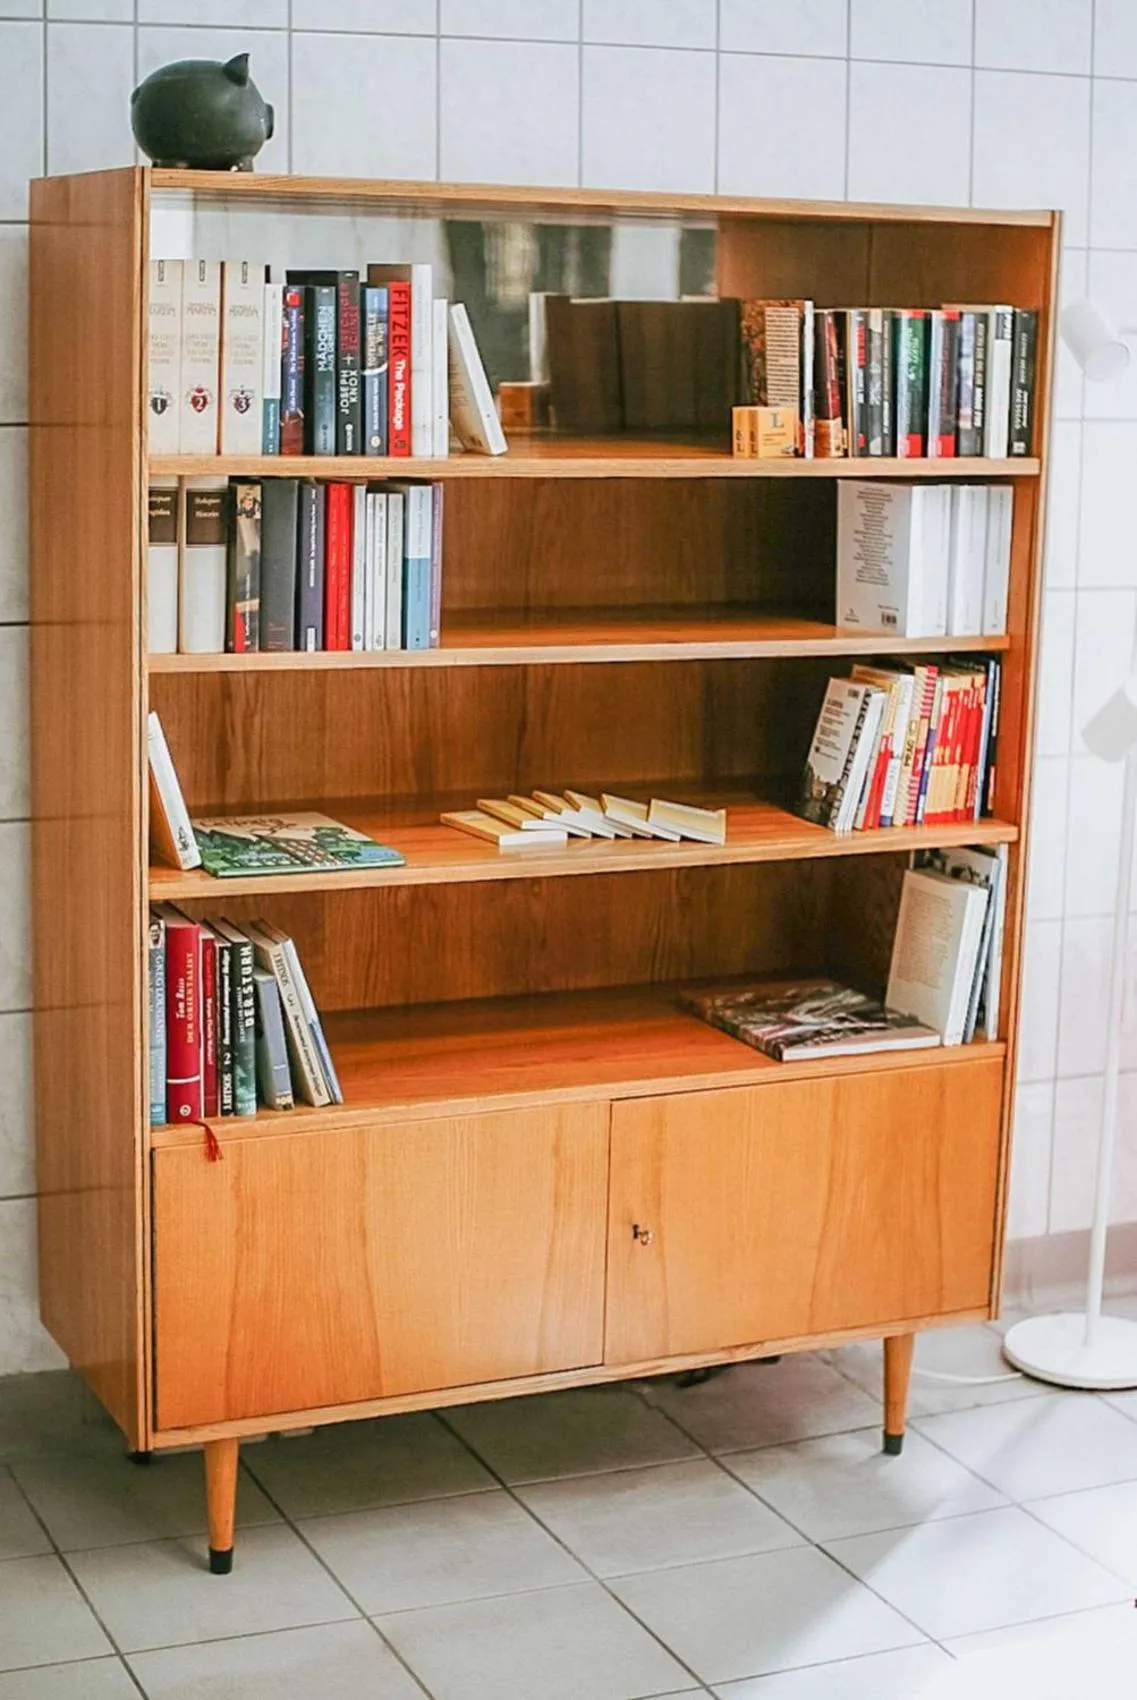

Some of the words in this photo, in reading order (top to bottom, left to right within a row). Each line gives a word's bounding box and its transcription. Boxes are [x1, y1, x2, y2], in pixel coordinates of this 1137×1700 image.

[315, 305, 328, 372] MÄDCHEN
[393, 289, 408, 357] FITZEK
[394, 359, 406, 377] The
[340, 369, 349, 415] JOSEPH
[348, 369, 358, 402] KNOX
[393, 382, 407, 431] Package
[770, 413, 785, 429] L
[240, 945, 254, 994] STURM
[175, 1002, 185, 1018] Tom
[243, 997, 255, 1028] DER
[187, 1022, 195, 1043] DER
[223, 1051, 231, 1064] 2
